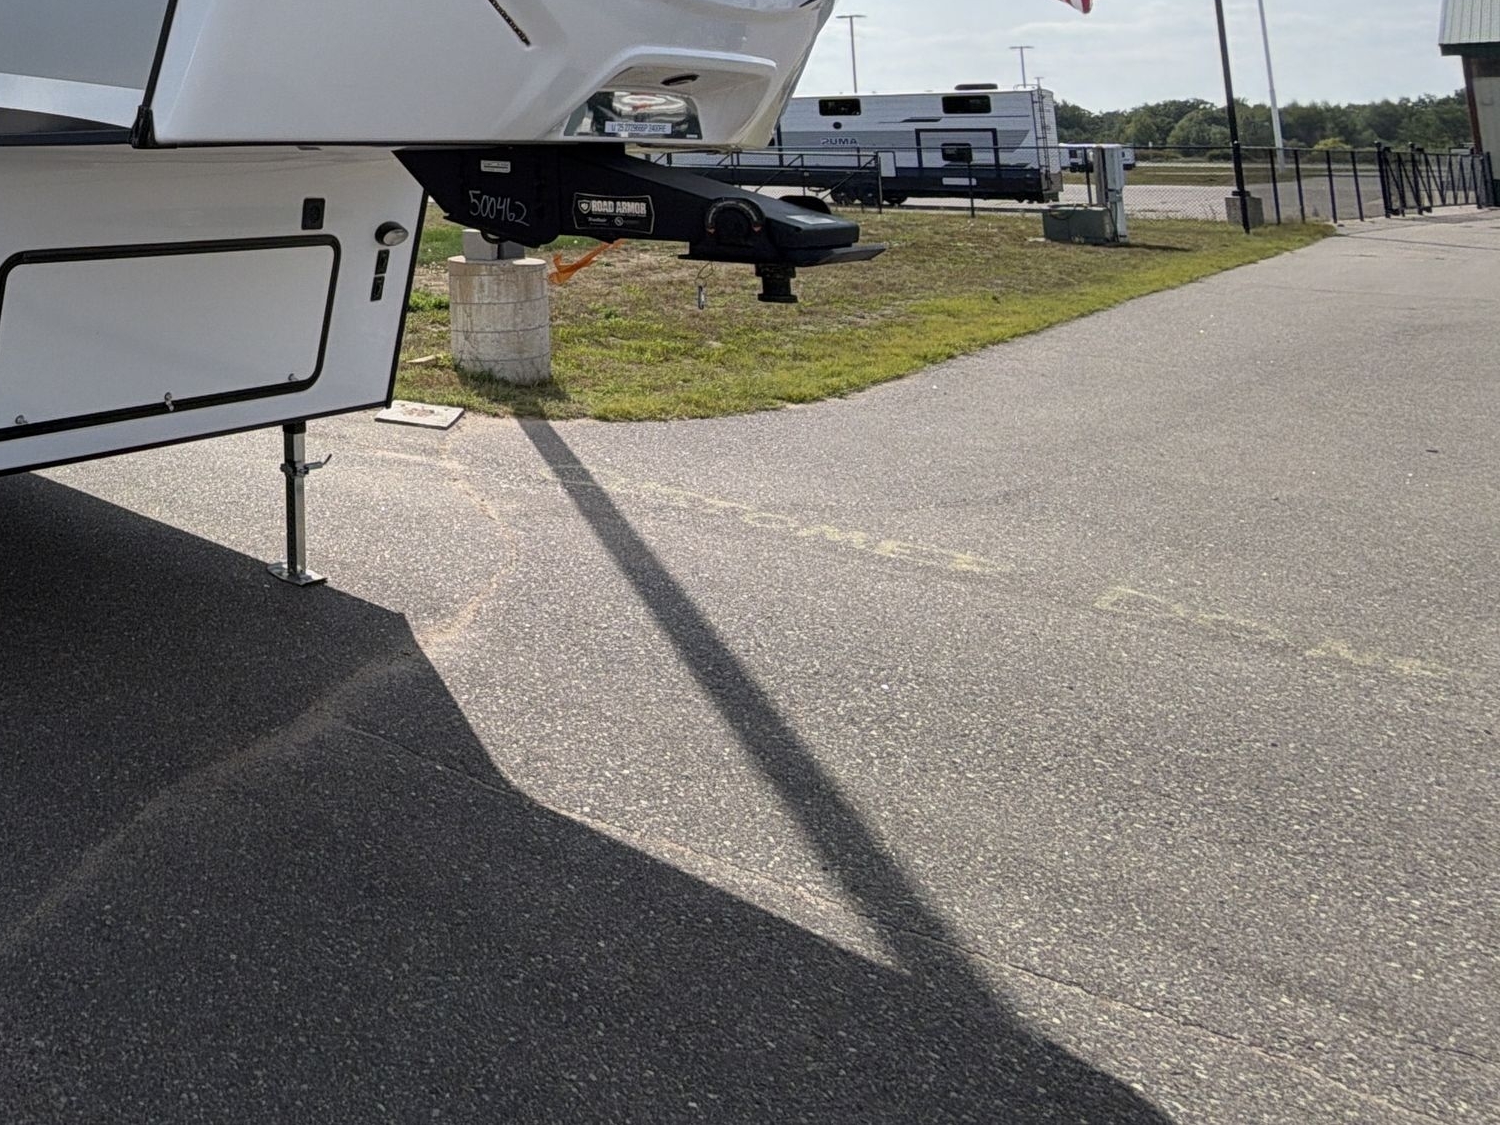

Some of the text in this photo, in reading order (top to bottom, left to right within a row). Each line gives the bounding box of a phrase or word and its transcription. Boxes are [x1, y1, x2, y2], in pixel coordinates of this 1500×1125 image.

[468, 189, 531, 227] 500462
[591, 200, 647, 215] ROAD ARMOR
